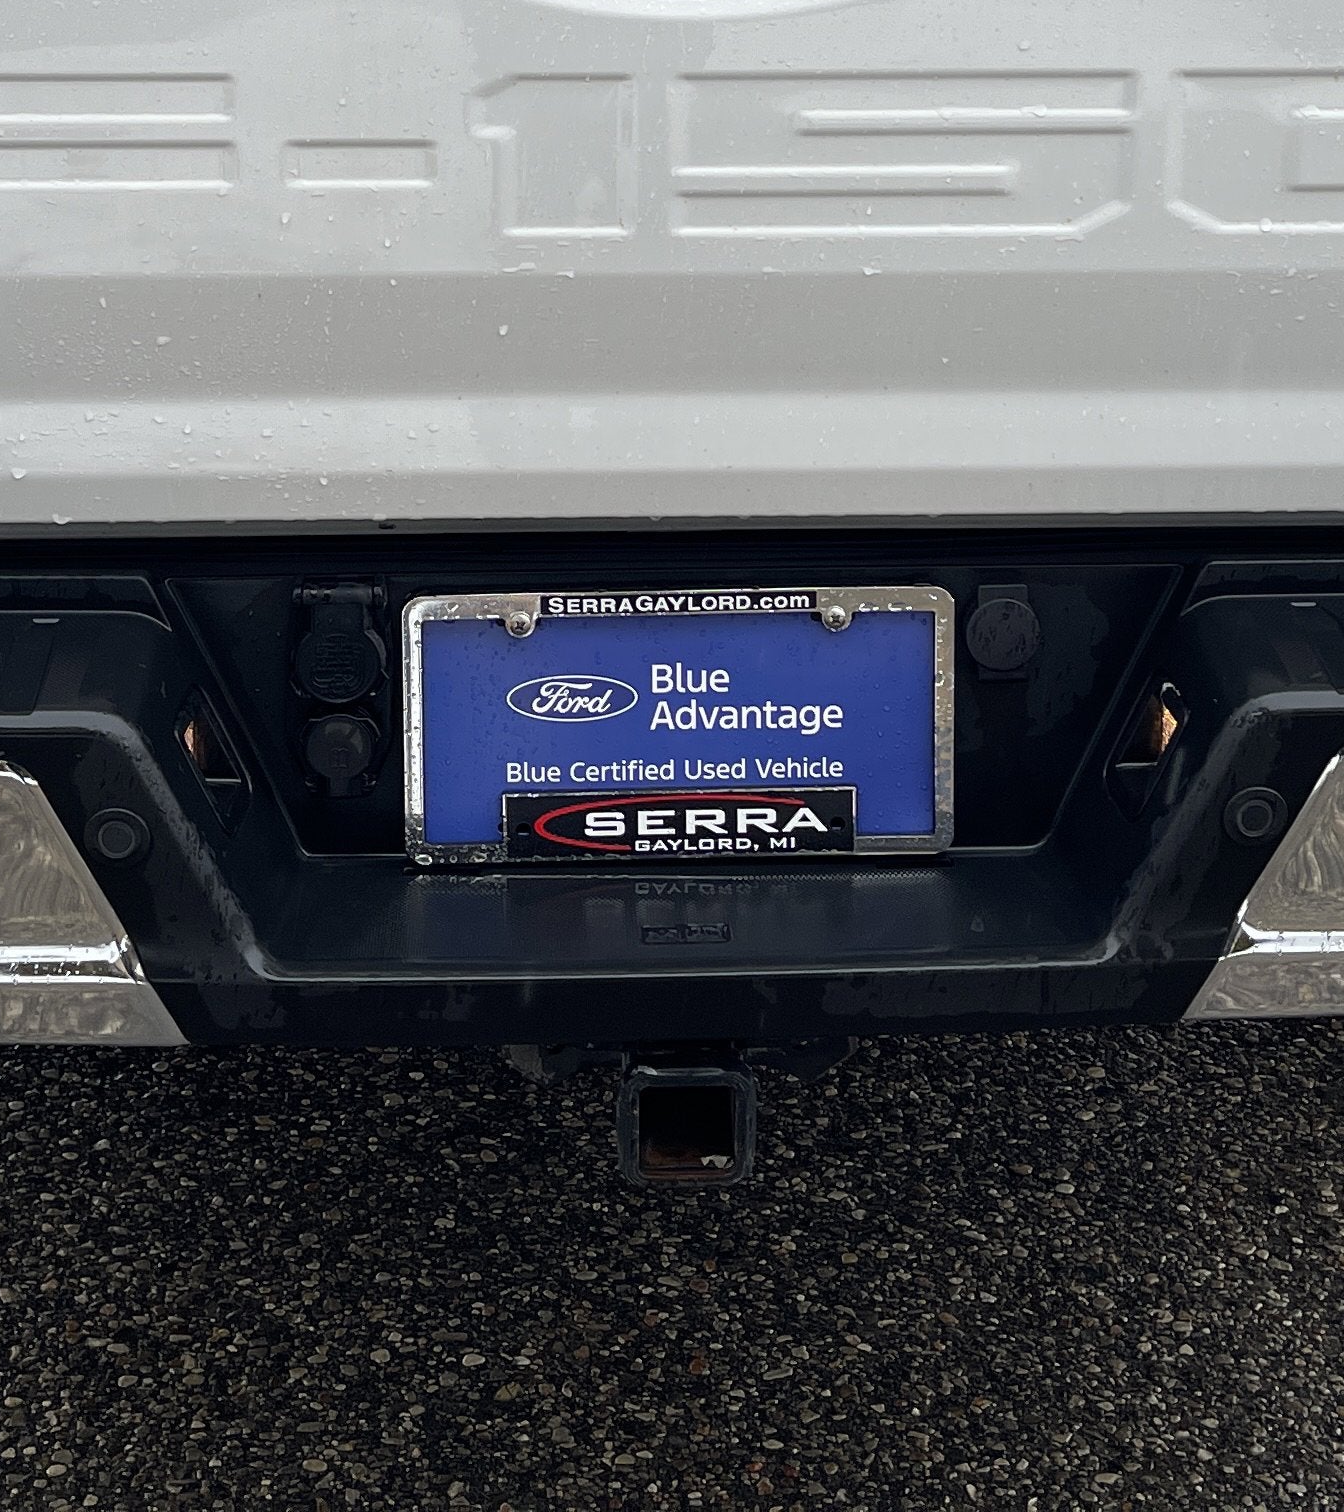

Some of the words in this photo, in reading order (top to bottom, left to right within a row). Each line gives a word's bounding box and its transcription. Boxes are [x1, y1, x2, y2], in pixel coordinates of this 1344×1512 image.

[547, 593, 811, 615] SERRAGAYLORD.com
[650, 663, 731, 695] Blue
[530, 681, 613, 715] Ford
[649, 698, 844, 735] Advantage
[505, 762, 562, 783] Blue
[569, 759, 675, 782] Certified
[684, 758, 747, 780] Used
[755, 756, 844, 779] Vehicle
[583, 806, 829, 837] SERRA
[633, 837, 760, 852] GAYLORD,
[769, 836, 797, 850] MI
